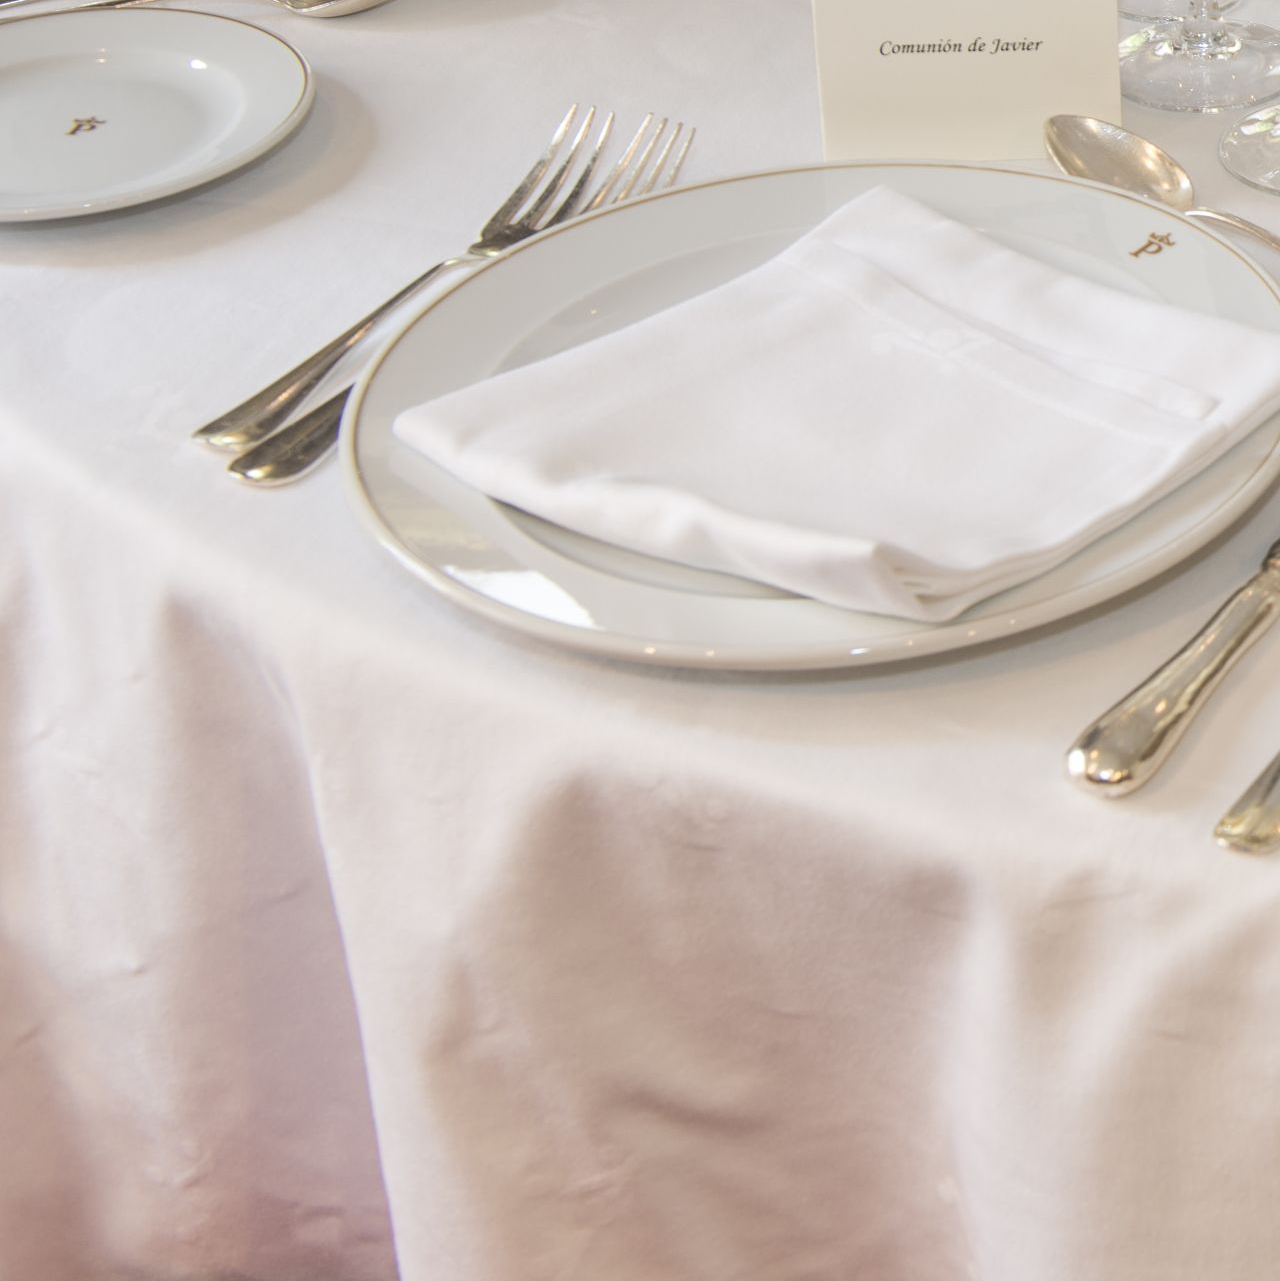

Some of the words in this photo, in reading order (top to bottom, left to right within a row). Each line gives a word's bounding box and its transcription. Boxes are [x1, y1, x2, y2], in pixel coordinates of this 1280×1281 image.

[879, 39, 962, 56] Comunión
[968, 37, 986, 53] de
[990, 37, 1043, 54] Javier
